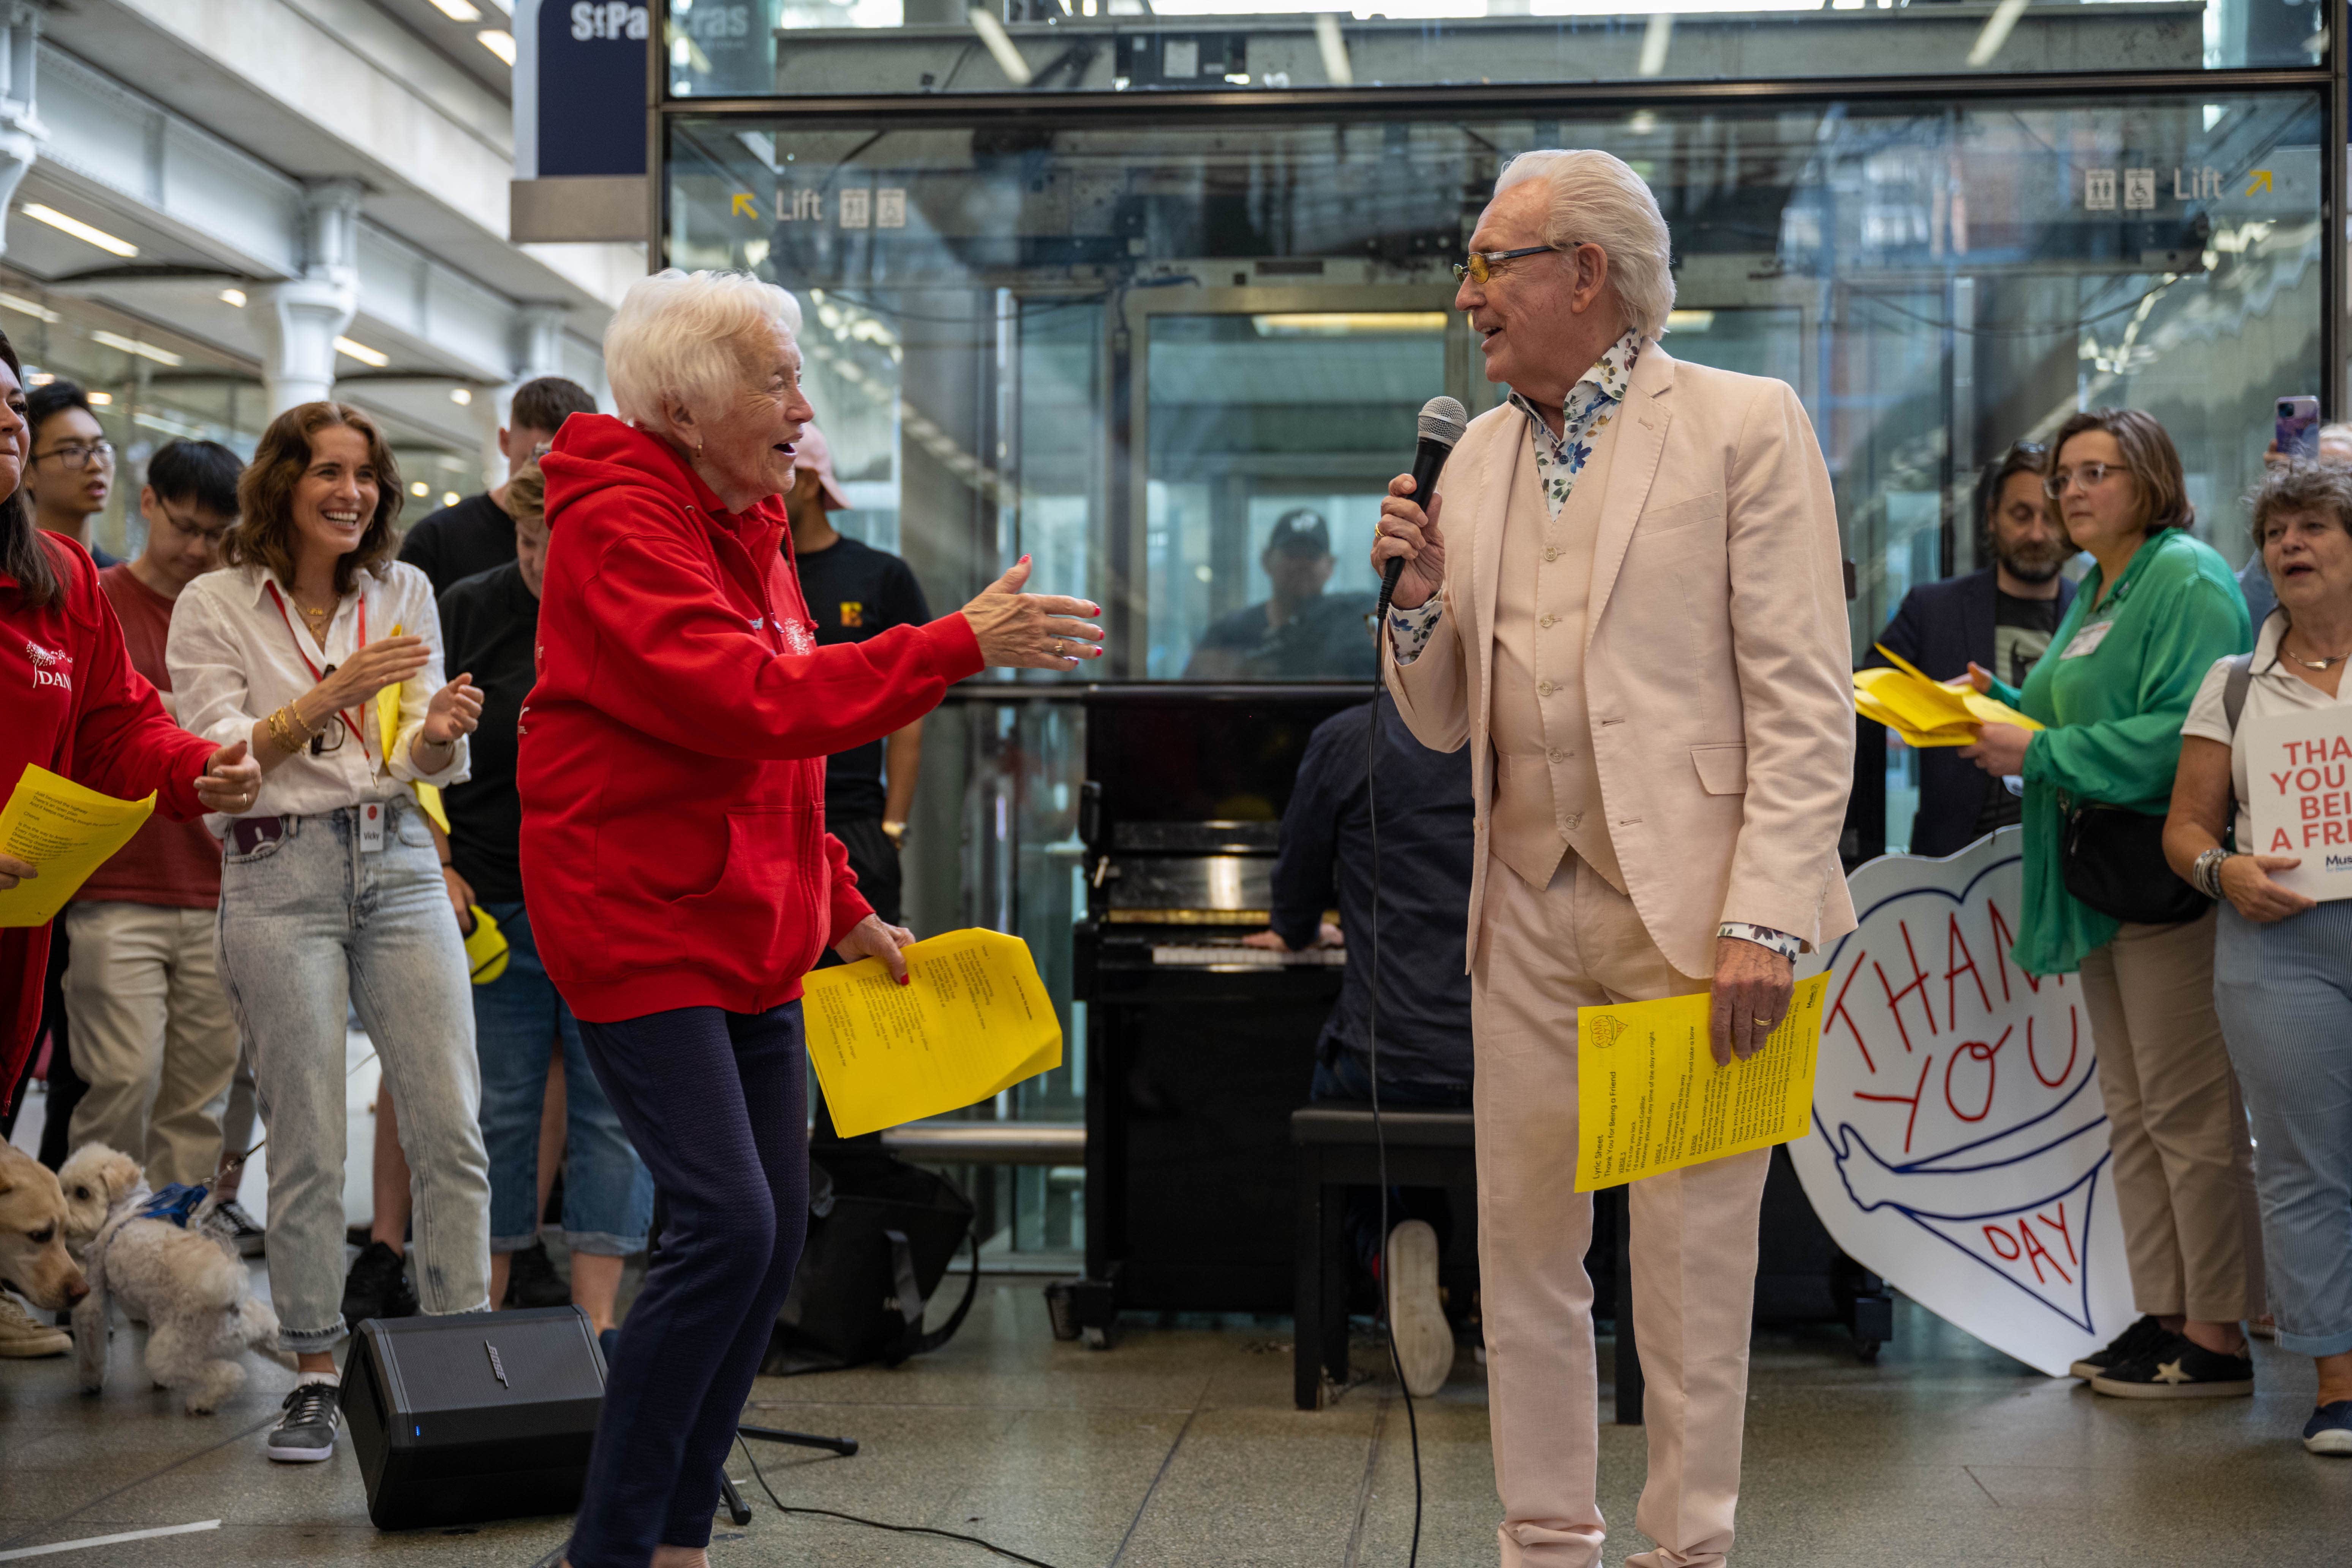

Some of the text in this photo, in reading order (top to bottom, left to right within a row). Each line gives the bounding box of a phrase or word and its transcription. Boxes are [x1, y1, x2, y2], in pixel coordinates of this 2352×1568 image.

[776, 189, 823, 222] Lift
[2174, 166, 2224, 201] Lift
[2270, 763, 2346, 795] YOU
[364, 831, 379, 842] Vicky
[2270, 827, 2293, 852] A
[1823, 899, 2064, 1074] THAN
[1854, 1005, 2077, 1154] YOU
[1593, 1134, 1603, 1179] Lyric Sheet
[1604, 1155, 1612, 1178] Thank
[1609, 1105, 1617, 1127] Being
[1983, 1202, 2077, 1285] DAY
[485, 1340, 508, 1387] BOSE
